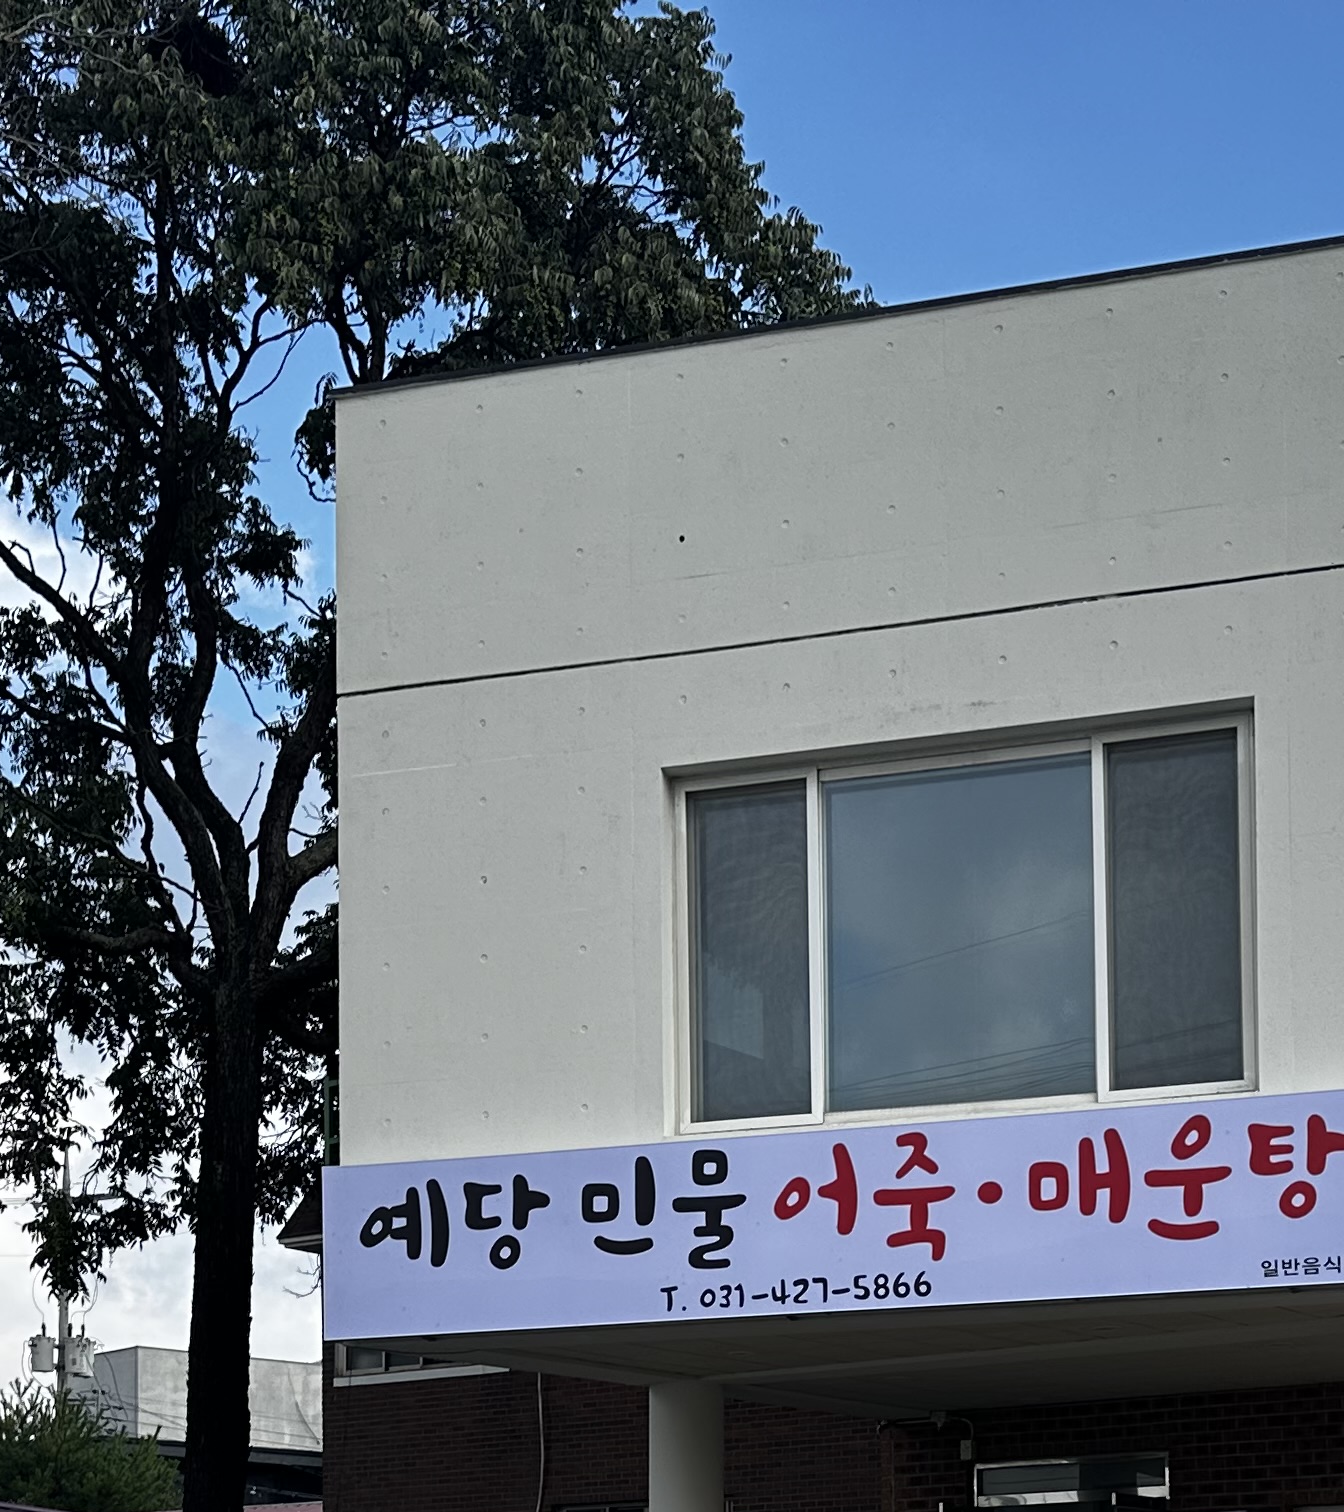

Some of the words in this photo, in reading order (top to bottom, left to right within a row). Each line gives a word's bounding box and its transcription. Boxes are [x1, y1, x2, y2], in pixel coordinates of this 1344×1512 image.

[359, 1174, 550, 1269] 예당
[581, 1149, 747, 1269] 민물
[660, 1285, 687, 1311] T.
[699, 1271, 932, 1308] 031-427-5866
